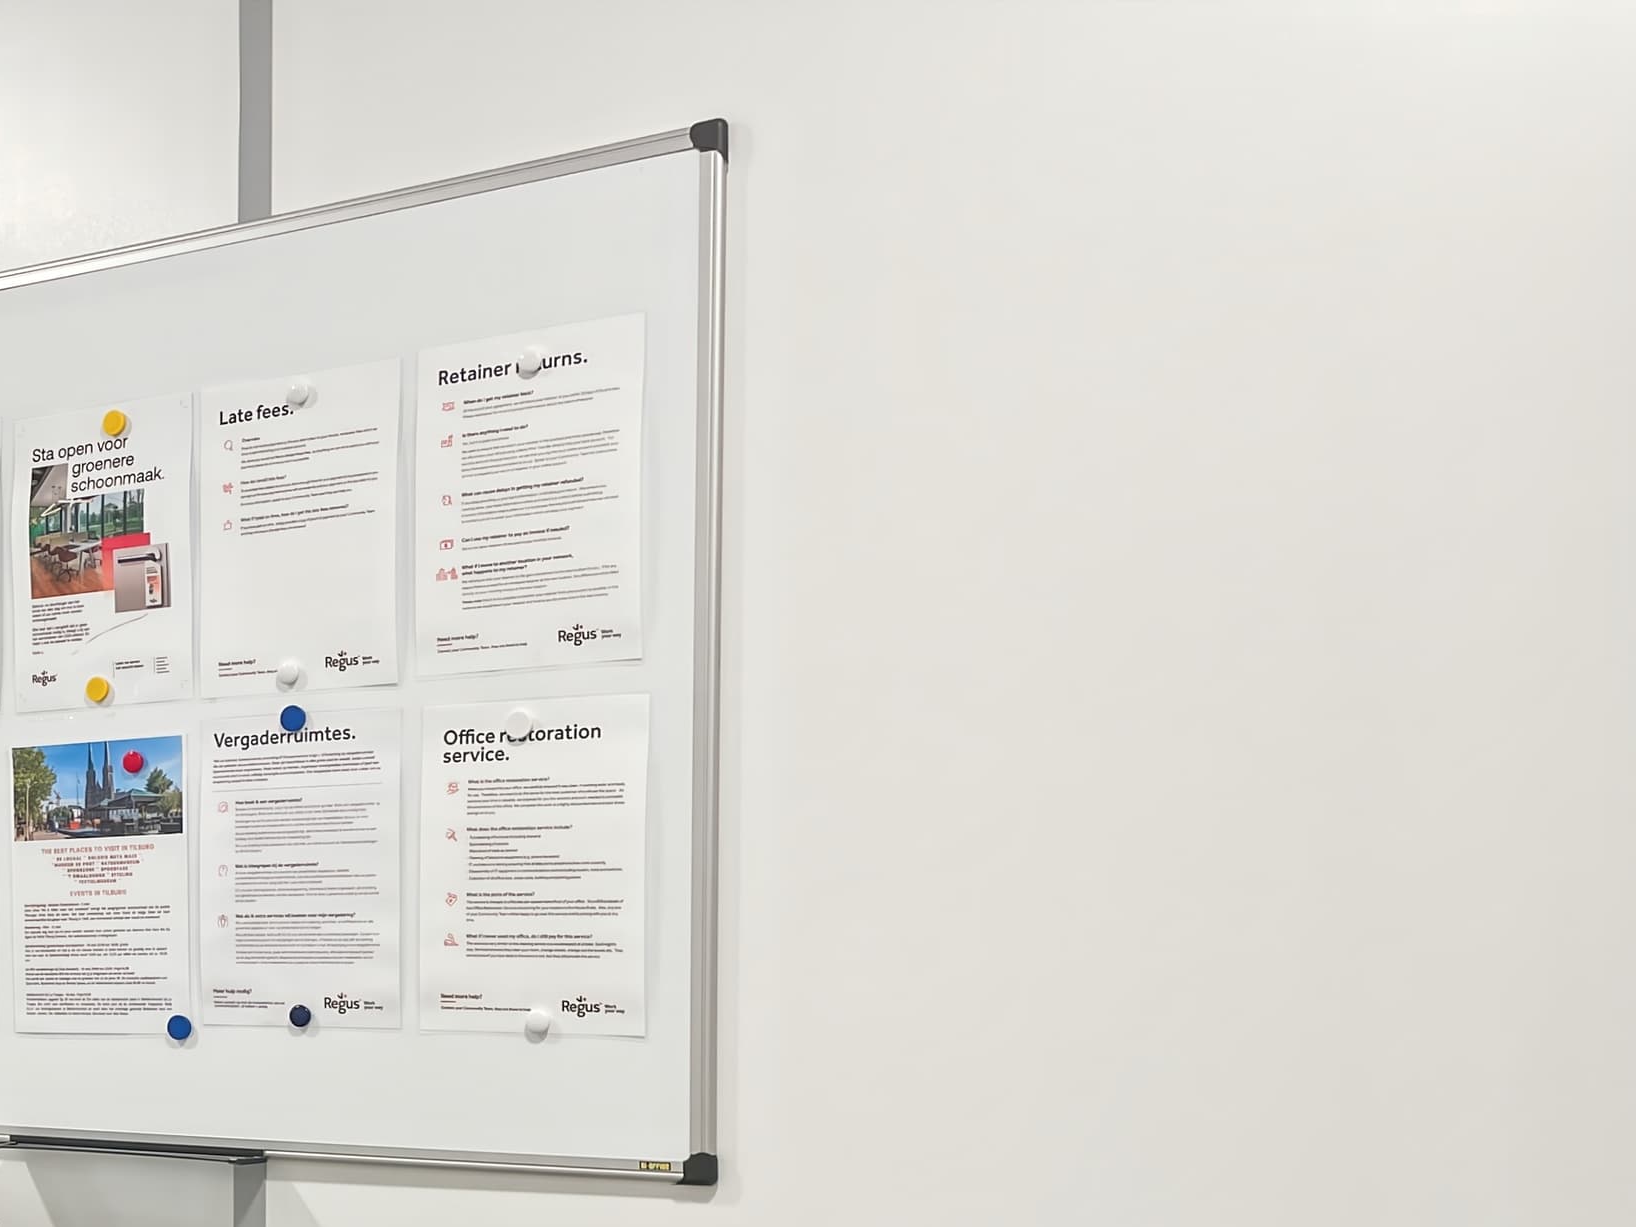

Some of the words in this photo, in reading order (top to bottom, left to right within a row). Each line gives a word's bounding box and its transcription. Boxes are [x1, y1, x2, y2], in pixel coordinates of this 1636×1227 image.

[438, 362, 512, 386] Retainer
[219, 409, 252, 425] Late
[257, 404, 294, 420] fees.
[32, 449, 54, 462] Sta
[58, 443, 93, 460] open
[98, 438, 128, 451] voor
[72, 455, 134, 478] groenere
[71, 467, 164, 492] schoonmaak.
[558, 628, 596, 646] Regus
[324, 655, 359, 672] Regus
[32, 674, 57, 686] Regus
[214, 727, 356, 750] Vergaderruimtes.
[444, 729, 495, 746] Office
[443, 747, 510, 764] service.
[324, 997, 360, 1014] Regus
[562, 1000, 600, 1018] Regus
